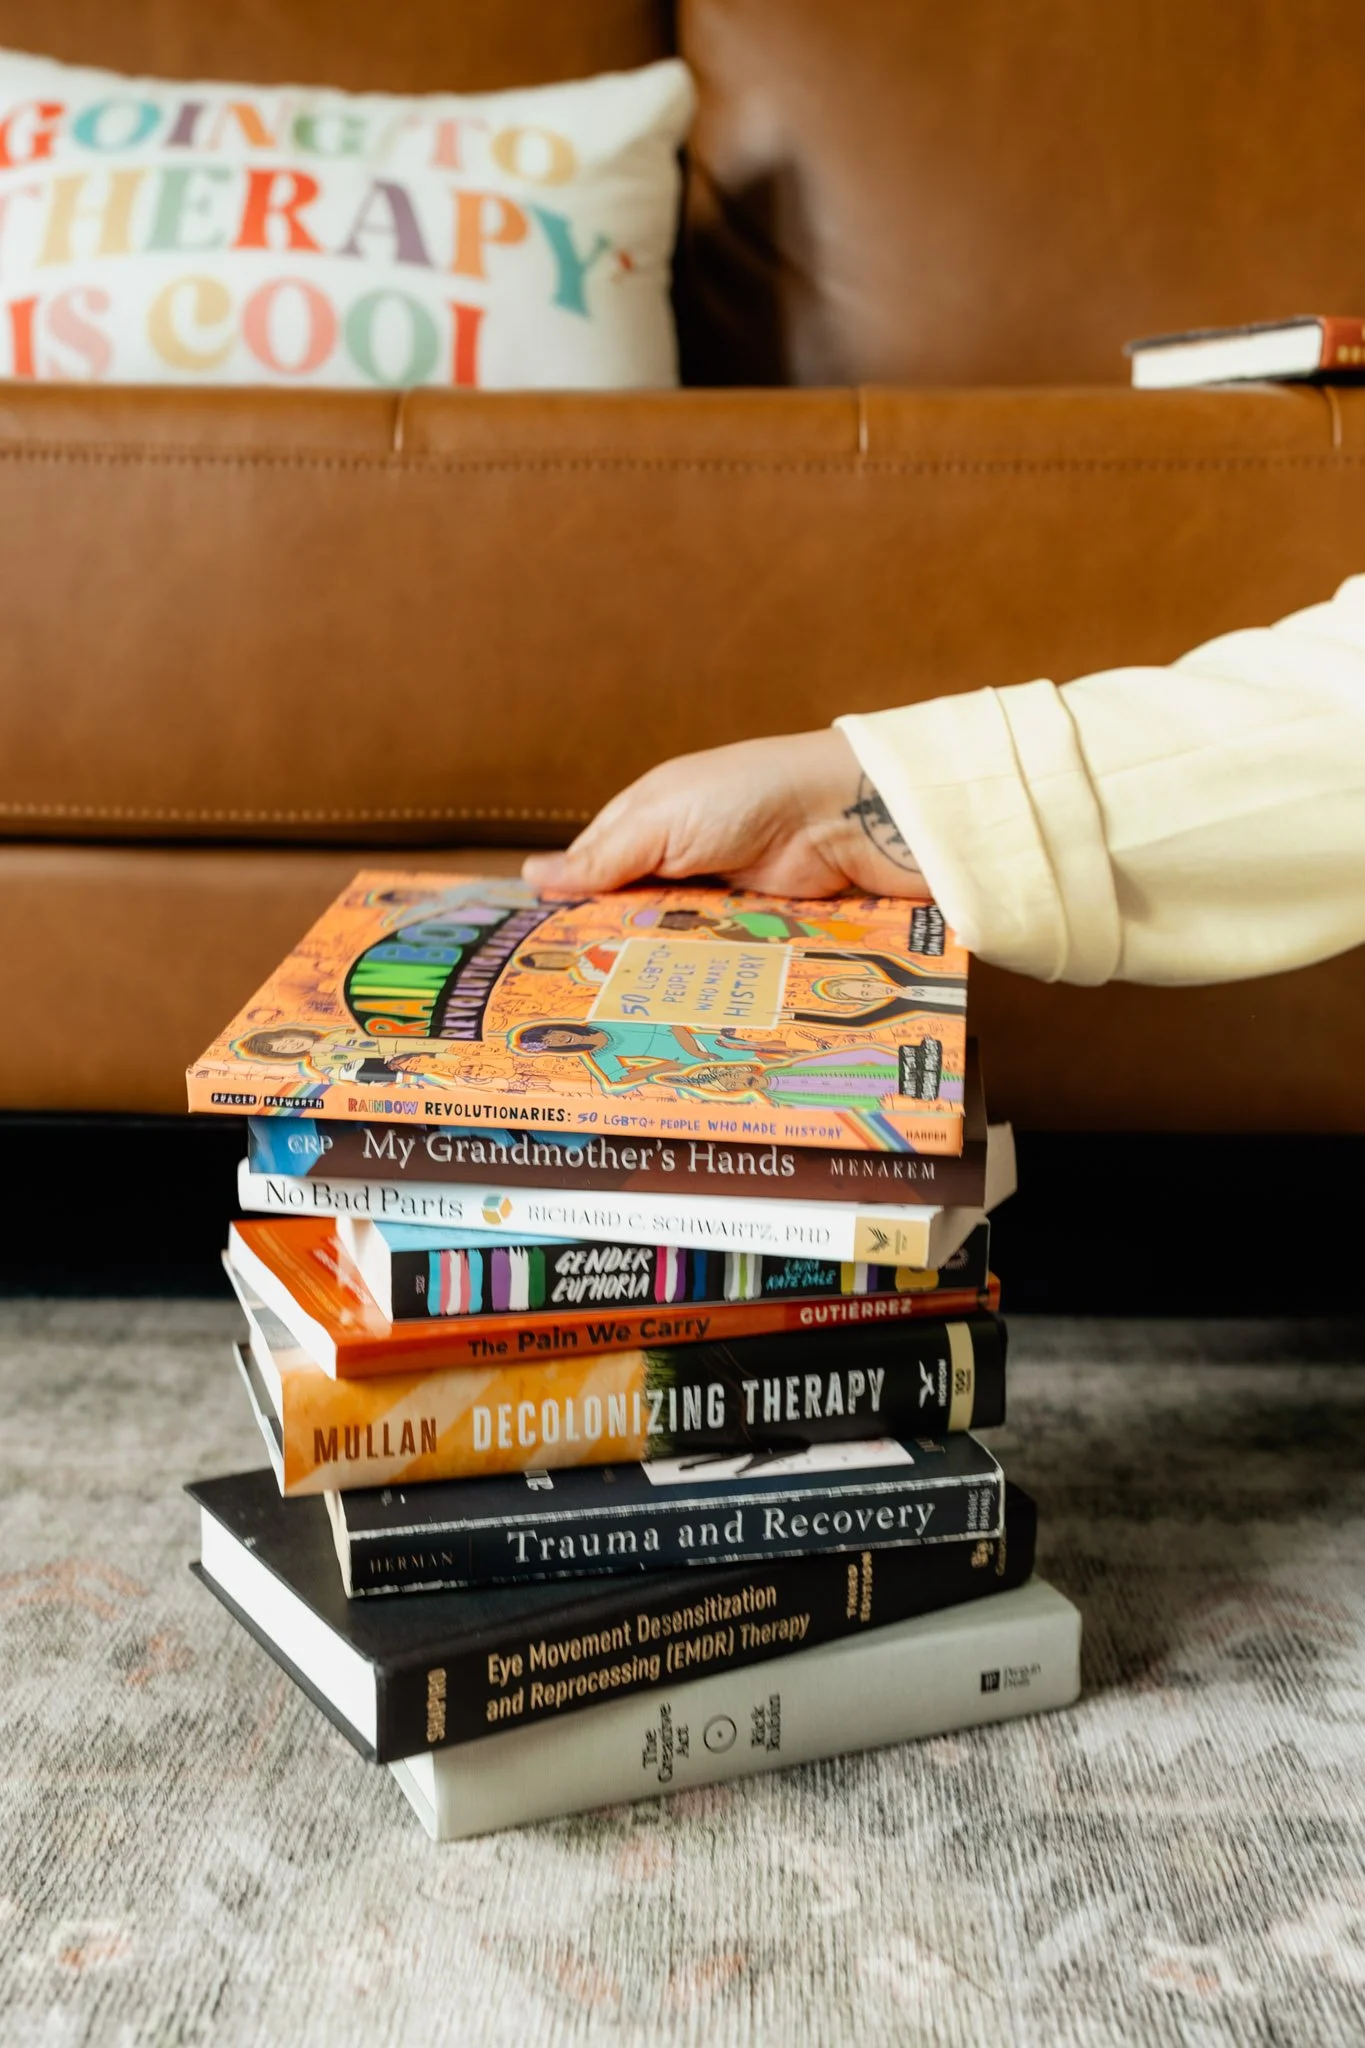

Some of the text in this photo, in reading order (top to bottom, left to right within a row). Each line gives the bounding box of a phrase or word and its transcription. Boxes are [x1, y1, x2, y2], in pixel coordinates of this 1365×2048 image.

[0, 98, 579, 187] GOING TO
[8, 286, 114, 381] IS
[621, 944, 672, 1017] 50 LGBTQ+
[661, 963, 696, 1003] PEOPLE
[692, 958, 730, 1011] WHO MADE
[723, 953, 767, 1017] HISTORY
[265, 1097, 323, 1108] PAPWORTH
[348, 1098, 419, 1115] RAINBOW
[425, 1101, 571, 1122] REVOLUTIONARIES:
[577, 1112, 598, 1124] 50
[604, 1113, 655, 1127] LGBTQ+
[660, 1119, 700, 1131] PEOPLE
[708, 1120, 737, 1133] WHO
[742, 1121, 776, 1136] MADE
[785, 1125, 843, 1140] HISTORY
[362, 1128, 415, 1169] My
[426, 1131, 675, 1172] Grandmother's
[688, 1141, 795, 1177] Hands
[830, 1157, 935, 1180] MENAKEM
[266, 1180, 831, 1244] No Bad Parts RICHARD C. SCHWARTZ, PHD
[551, 1272, 650, 1303] EUPHORIA
[554, 1246, 653, 1275] GENDER
[469, 1340, 508, 1357] The
[518, 1326, 578, 1353] Pain
[586, 1322, 631, 1345] We
[640, 1317, 711, 1340] Carry
[313, 1368, 885, 1464] MULLAN DECOLONIZING THERAPY
[507, 1527, 660, 1563] Trauma
[678, 1510, 744, 1549] and
[762, 1502, 935, 1541] Recovery
[486, 1612, 811, 1722] and Reprocessing (EMDR) Therapy
[488, 1584, 777, 1688] Eye Movement Desensitization
